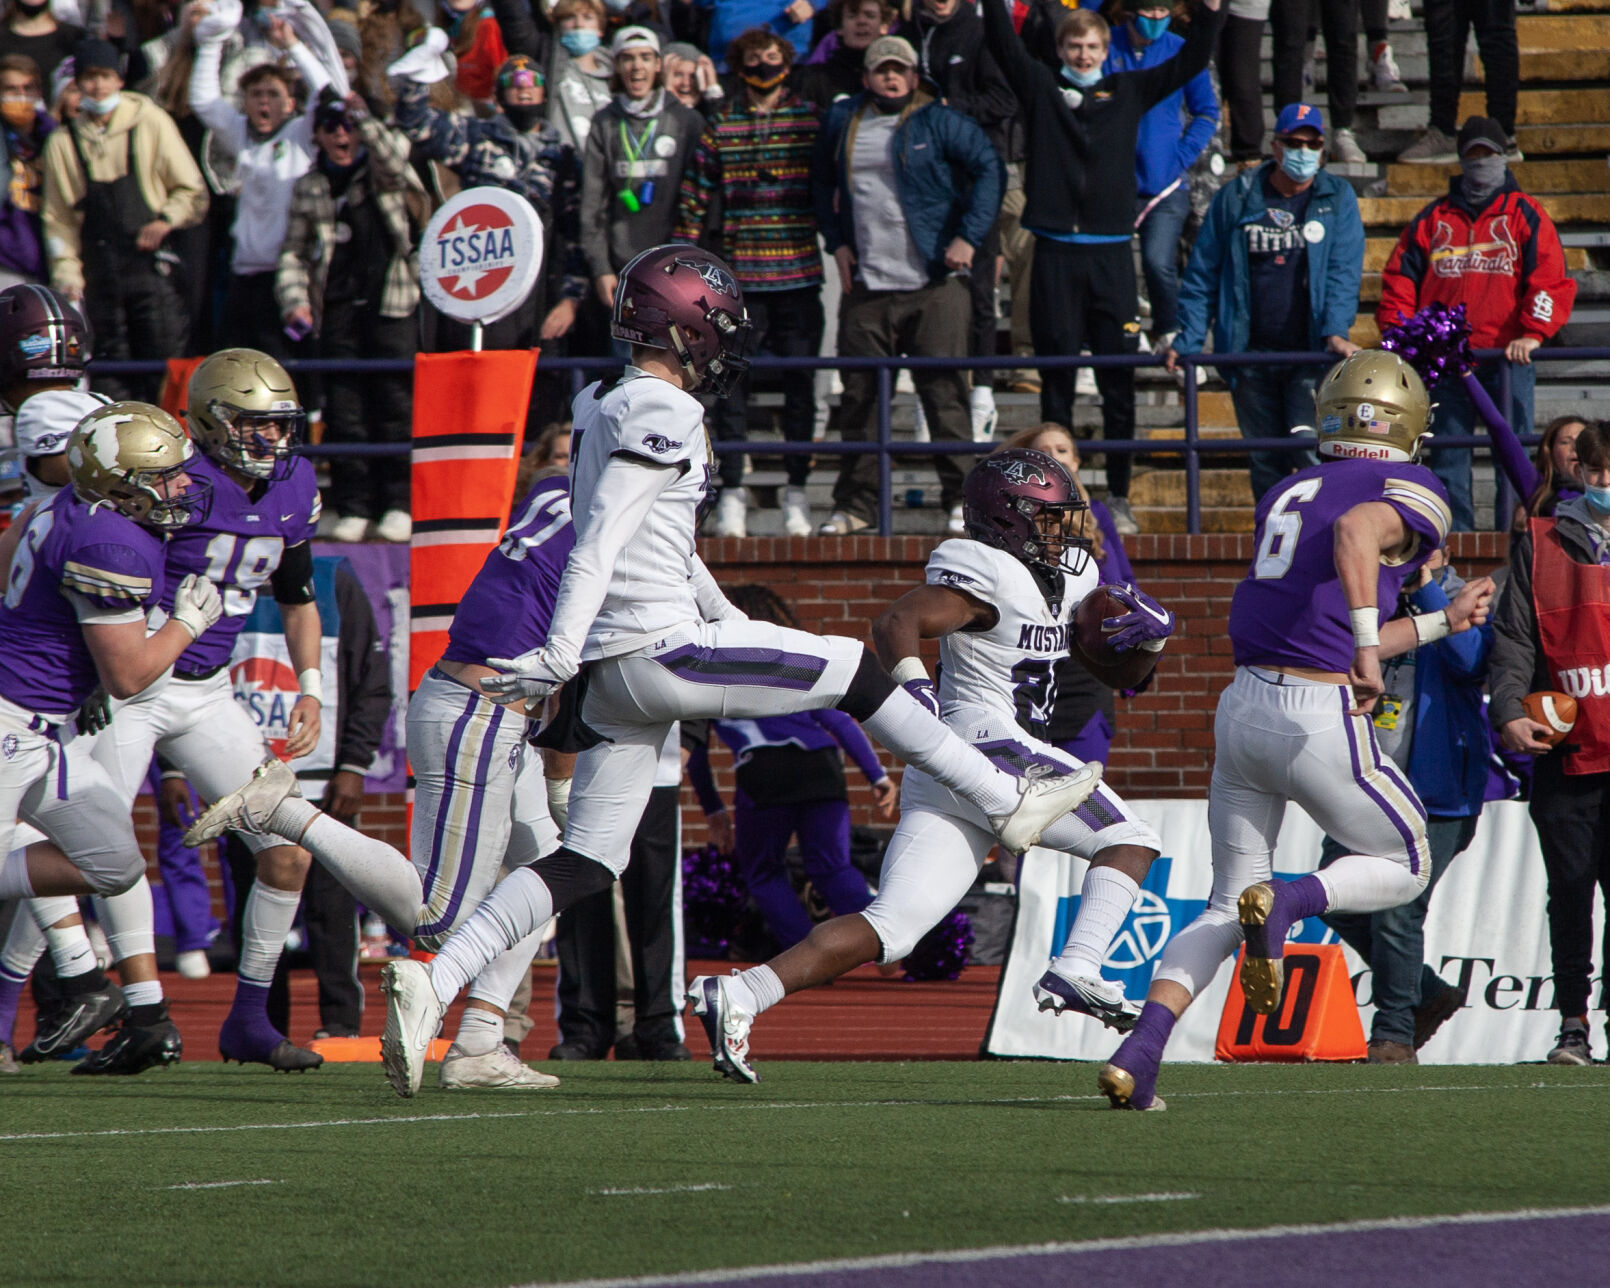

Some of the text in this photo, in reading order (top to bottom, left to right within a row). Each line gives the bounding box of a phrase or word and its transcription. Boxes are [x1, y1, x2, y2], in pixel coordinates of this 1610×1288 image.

[1296, 105, 1311, 120] F
[437, 228, 515, 269] TSSAA
[1244, 224, 1307, 252] TITAN
[1432, 251, 1514, 277] Cardinals
[1360, 405, 1371, 418] E
[1332, 444, 1390, 460] Riddell
[1255, 476, 1323, 580] 6
[654, 639, 667, 651] LA
[1016, 623, 1073, 653] MUSTAN
[976, 729, 989, 740] LA
[1439, 955, 1606, 1010] Ten
